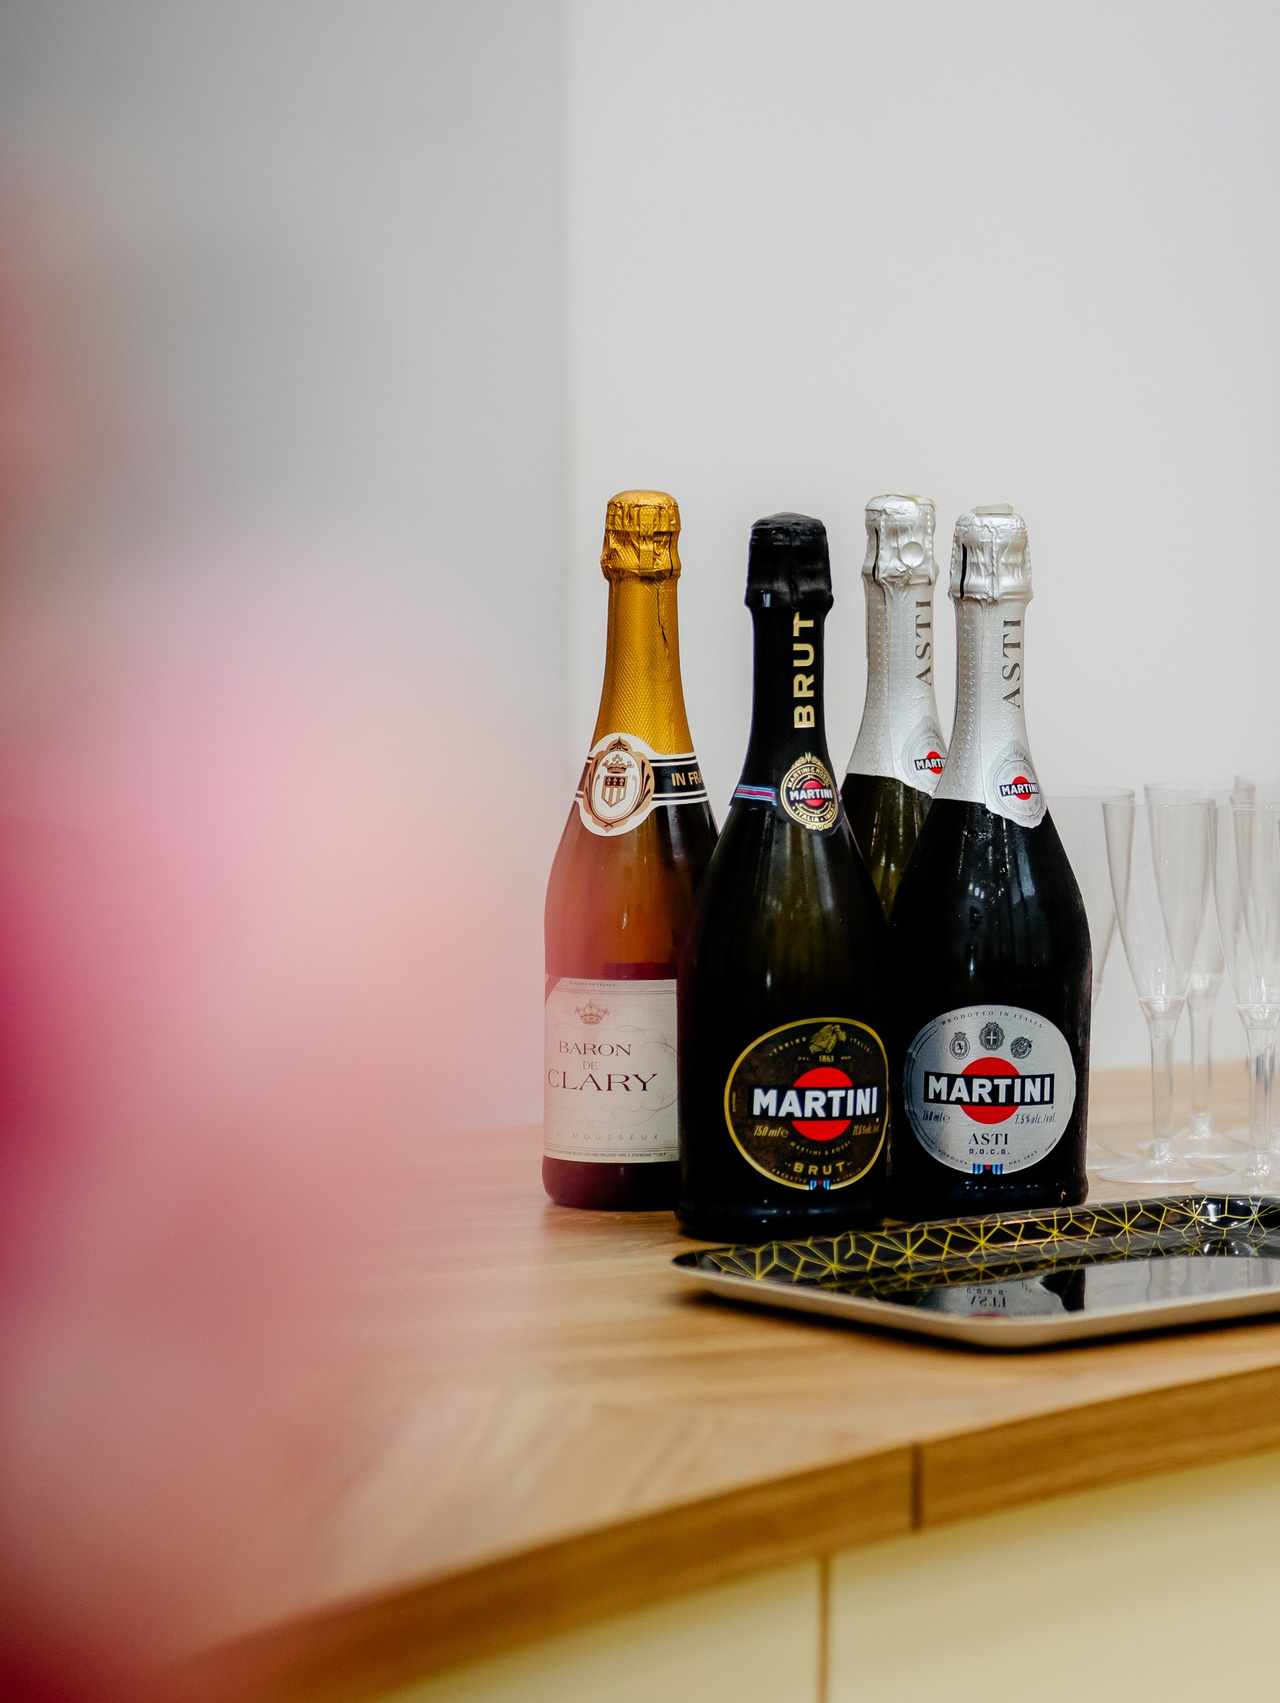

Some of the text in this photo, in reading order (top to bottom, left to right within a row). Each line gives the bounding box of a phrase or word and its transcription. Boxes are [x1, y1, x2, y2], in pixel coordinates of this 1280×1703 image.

[915, 600, 932, 687] ASTI
[793, 611, 816, 728] BRUT
[1002, 618, 1022, 709] ASTI
[671, 772, 687, 787] IN
[789, 788, 834, 801] MARTINI
[795, 809, 820, 823] ITALIA
[941, 1010, 994, 1027] PRODOTTO
[1013, 1013, 1043, 1029] ITALIA
[558, 1040, 631, 1056] BARON
[582, 1061, 598, 1071] DE
[547, 1069, 658, 1092] CLARY
[928, 1075, 1051, 1104] MARTINI
[753, 1086, 878, 1118] MARTINI
[571, 1132, 658, 1141] MOUSSEUX
[968, 1133, 1009, 1146] ASTI
[793, 1161, 846, 1176] BRUT
